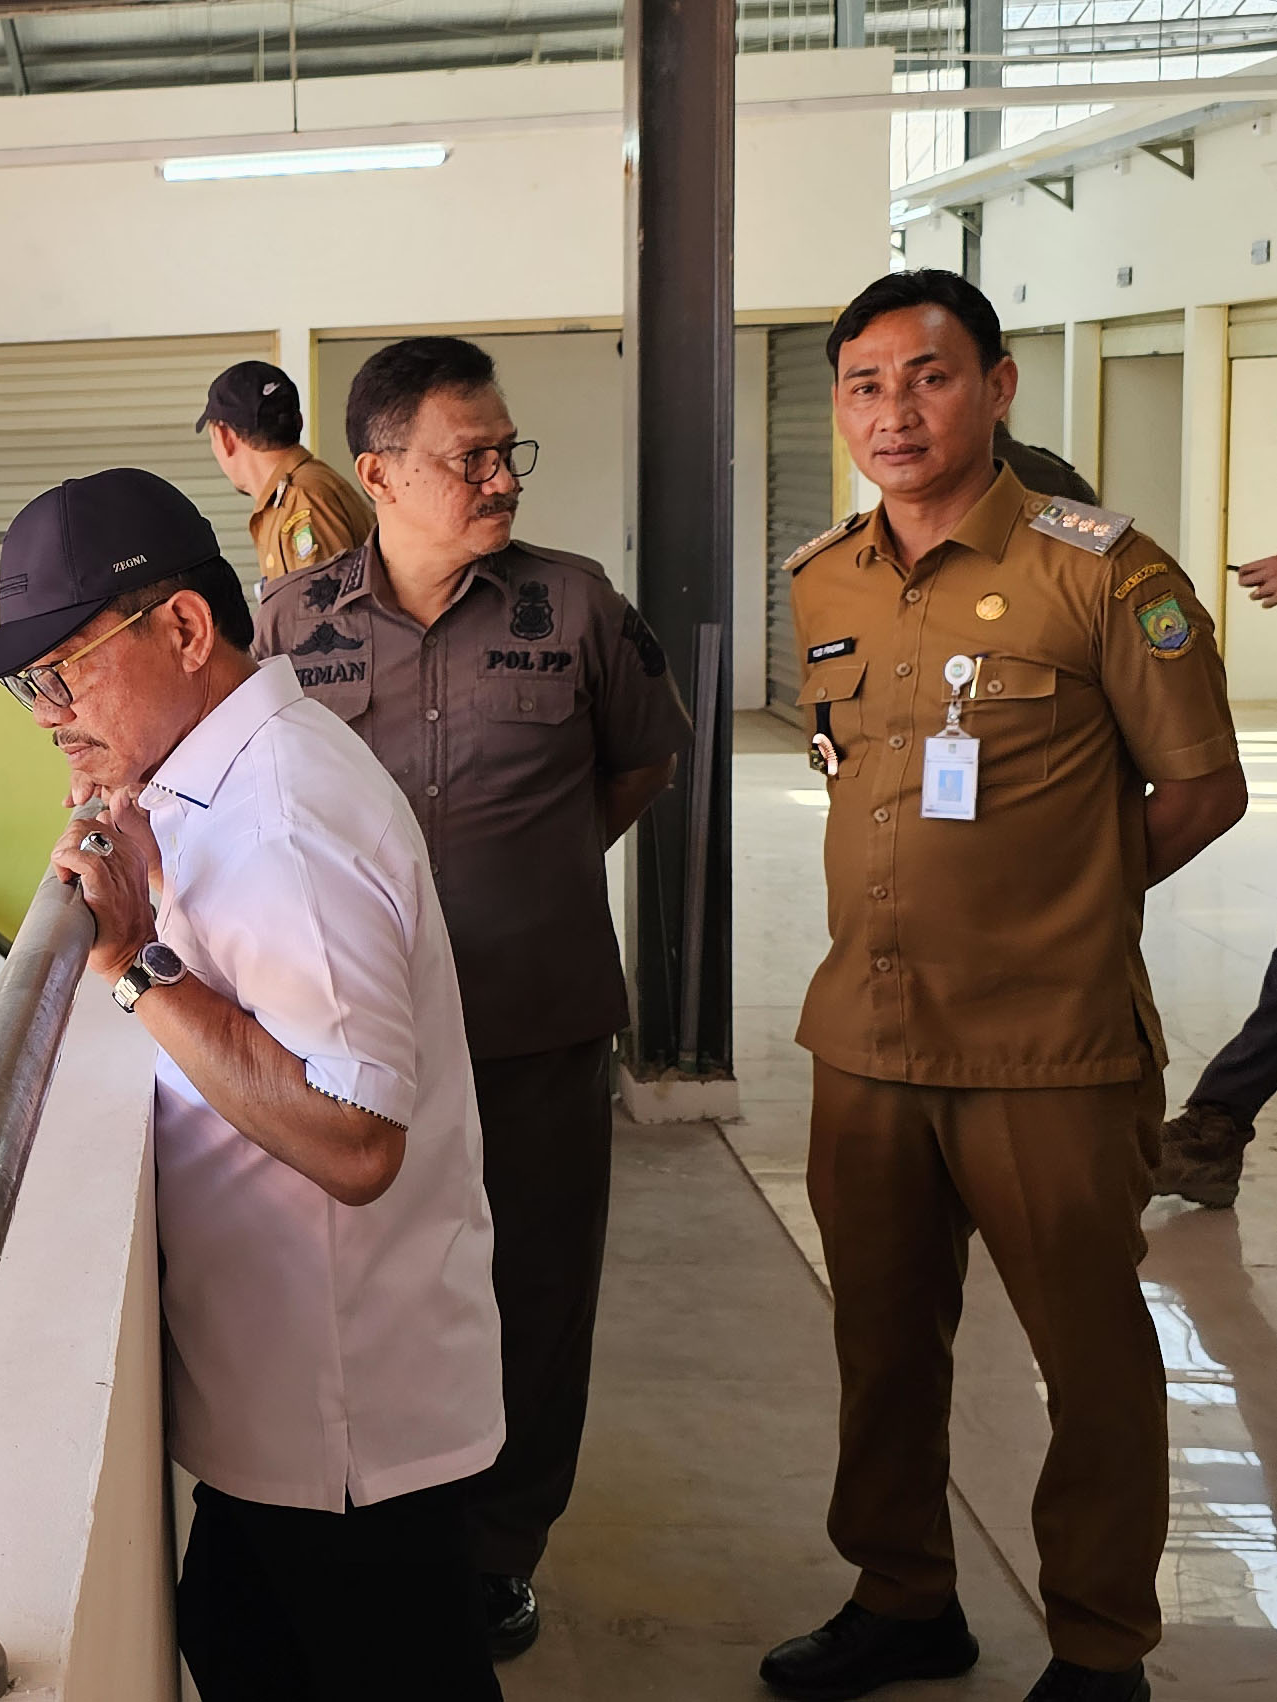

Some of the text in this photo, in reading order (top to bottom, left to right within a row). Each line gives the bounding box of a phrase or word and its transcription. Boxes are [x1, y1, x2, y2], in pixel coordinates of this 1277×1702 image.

[112, 554, 148, 573] ZEGNA
[486, 650, 573, 673] POL PP
[295, 662, 366, 688] RMAN
